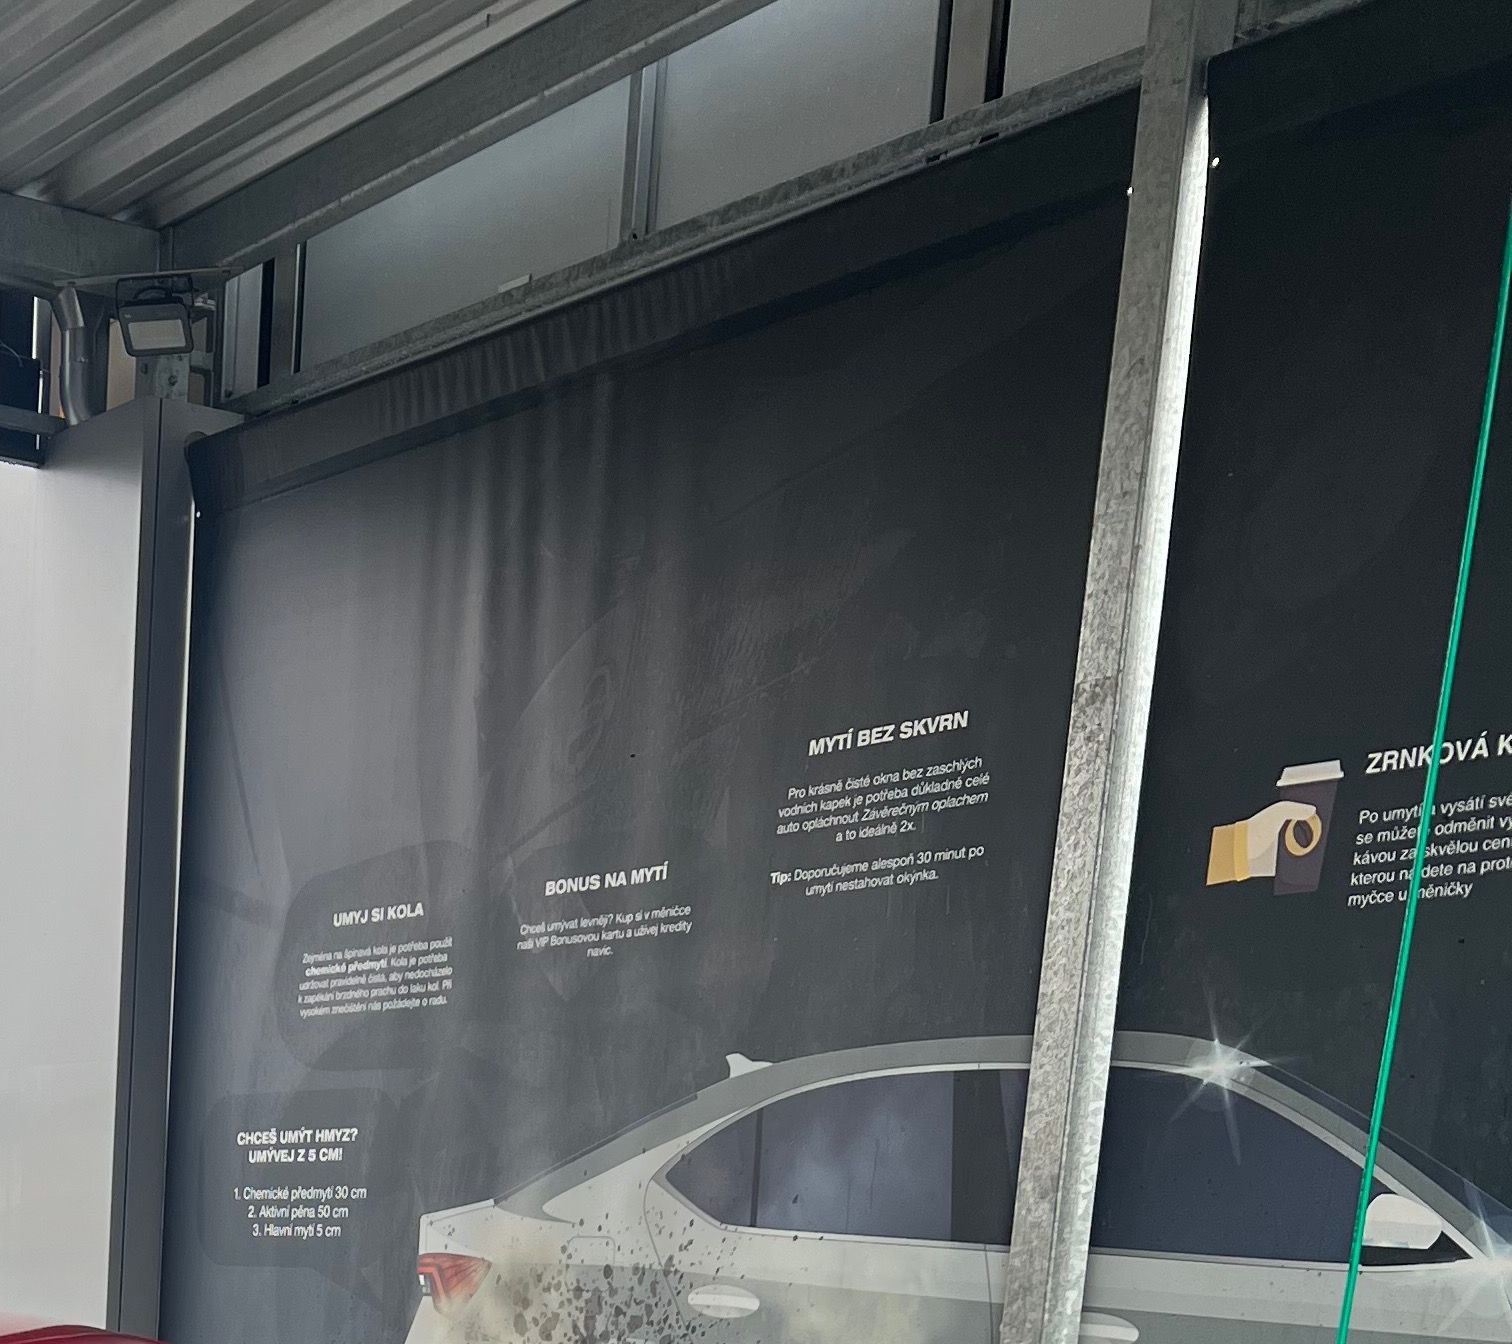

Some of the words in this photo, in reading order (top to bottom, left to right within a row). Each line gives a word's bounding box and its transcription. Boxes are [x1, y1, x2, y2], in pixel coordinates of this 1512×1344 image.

[808, 728, 853, 756] MYTÍ
[857, 725, 895, 747] BEZ
[899, 711, 968, 739] SKVRN
[1366, 731, 1489, 774] ZRNKOVÁ
[788, 788, 806, 800] Pro
[845, 775, 871, 790] čisté
[873, 772, 900, 785] okna
[903, 767, 923, 780] bez
[926, 756, 982, 777] zaschlých
[778, 803, 818, 818] vodních
[820, 796, 851, 813] kapek
[853, 794, 863, 808] je
[866, 787, 908, 805] potřeba
[965, 772, 990, 787] celé
[776, 820, 799, 834] auto
[802, 811, 860, 831] opláchnout
[862, 801, 929, 822] Závěrečným
[931, 792, 988, 811] oplachem
[1359, 810, 1378, 824] Po
[1441, 794, 1485, 816] vysátí
[835, 832, 843, 842] a
[845, 828, 857, 841] to
[859, 824, 897, 838] ideálně
[1356, 832, 1373, 845] se
[1435, 815, 1494, 836] odměnit
[1353, 851, 1396, 865] kávou
[1424, 840, 1478, 857] skvělou
[1483, 837, 1512, 849] cen
[545, 874, 600, 896] BONUS
[605, 871, 627, 888] NA
[631, 861, 669, 885] MYTÍ
[770, 872, 792, 886] Tip:
[794, 859, 869, 882] Doporučujeme
[871, 853, 914, 871] alespoň
[917, 851, 931, 864] 30
[934, 847, 966, 862] minut
[969, 846, 985, 861] po
[1350, 872, 1395, 886] kterou
[1457, 862, 1476, 874] na
[1480, 857, 1512, 875] prot
[805, 882, 834, 897] umytí
[835, 873, 894, 892] nestahovat
[896, 868, 939, 885] okýnka.
[1347, 890, 1394, 908] myčce
[1398, 891, 1408, 901] u
[333, 909, 368, 927] UMYJ
[371, 907, 384, 922] SI
[387, 902, 424, 920] KOLA
[547, 919, 578, 932] umývat
[580, 915, 613, 929] levněji?
[616, 913, 633, 924] Kup
[635, 911, 643, 921] si
[644, 911, 649, 920] v
[651, 905, 691, 918] měničce
[536, 936, 549, 948] VIP
[550, 932, 599, 946] Bonusovou
[601, 929, 624, 942] kartu
[626, 929, 632, 938] a
[660, 920, 692, 933] kredity
[373, 945, 388, 955] kola
[389, 944, 397, 956] je
[398, 940, 428, 954] potřeba
[391, 956, 408, 966] Kola
[409, 955, 417, 967] je
[418, 953, 447, 965] potřeba
[587, 945, 613, 958] navíc.
[389, 972, 403, 983] aby
[398, 984, 409, 995] do
[410, 983, 426, 993] laku
[422, 998, 427, 1007] o
[237, 1128, 277, 1145] CHCEŠ
[279, 1127, 313, 1144] UMÝT
[315, 1128, 358, 1142] HMYZ?
[248, 1147, 294, 1163] UMÝVEJ
[297, 1149, 305, 1162] Z
[308, 1149, 316, 1162] 5
[319, 1148, 343, 1161] CM!
[234, 1188, 241, 1199] 1.
[243, 1186, 289, 1200] Chemické
[291, 1185, 334, 1202] předmytí
[335, 1186, 348, 1199] 30
[351, 1188, 367, 1199] cm
[248, 1206, 257, 1218] 2.
[259, 1204, 290, 1218] Aktivní
[291, 1205, 315, 1220] pěna
[317, 1205, 331, 1218] 50
[332, 1207, 349, 1218] cm
[252, 1224, 262, 1236] 3.
[264, 1223, 293, 1236] Hlavní
[294, 1223, 315, 1240] mytí
[316, 1224, 324, 1236] 5
[325, 1225, 341, 1237] cm
